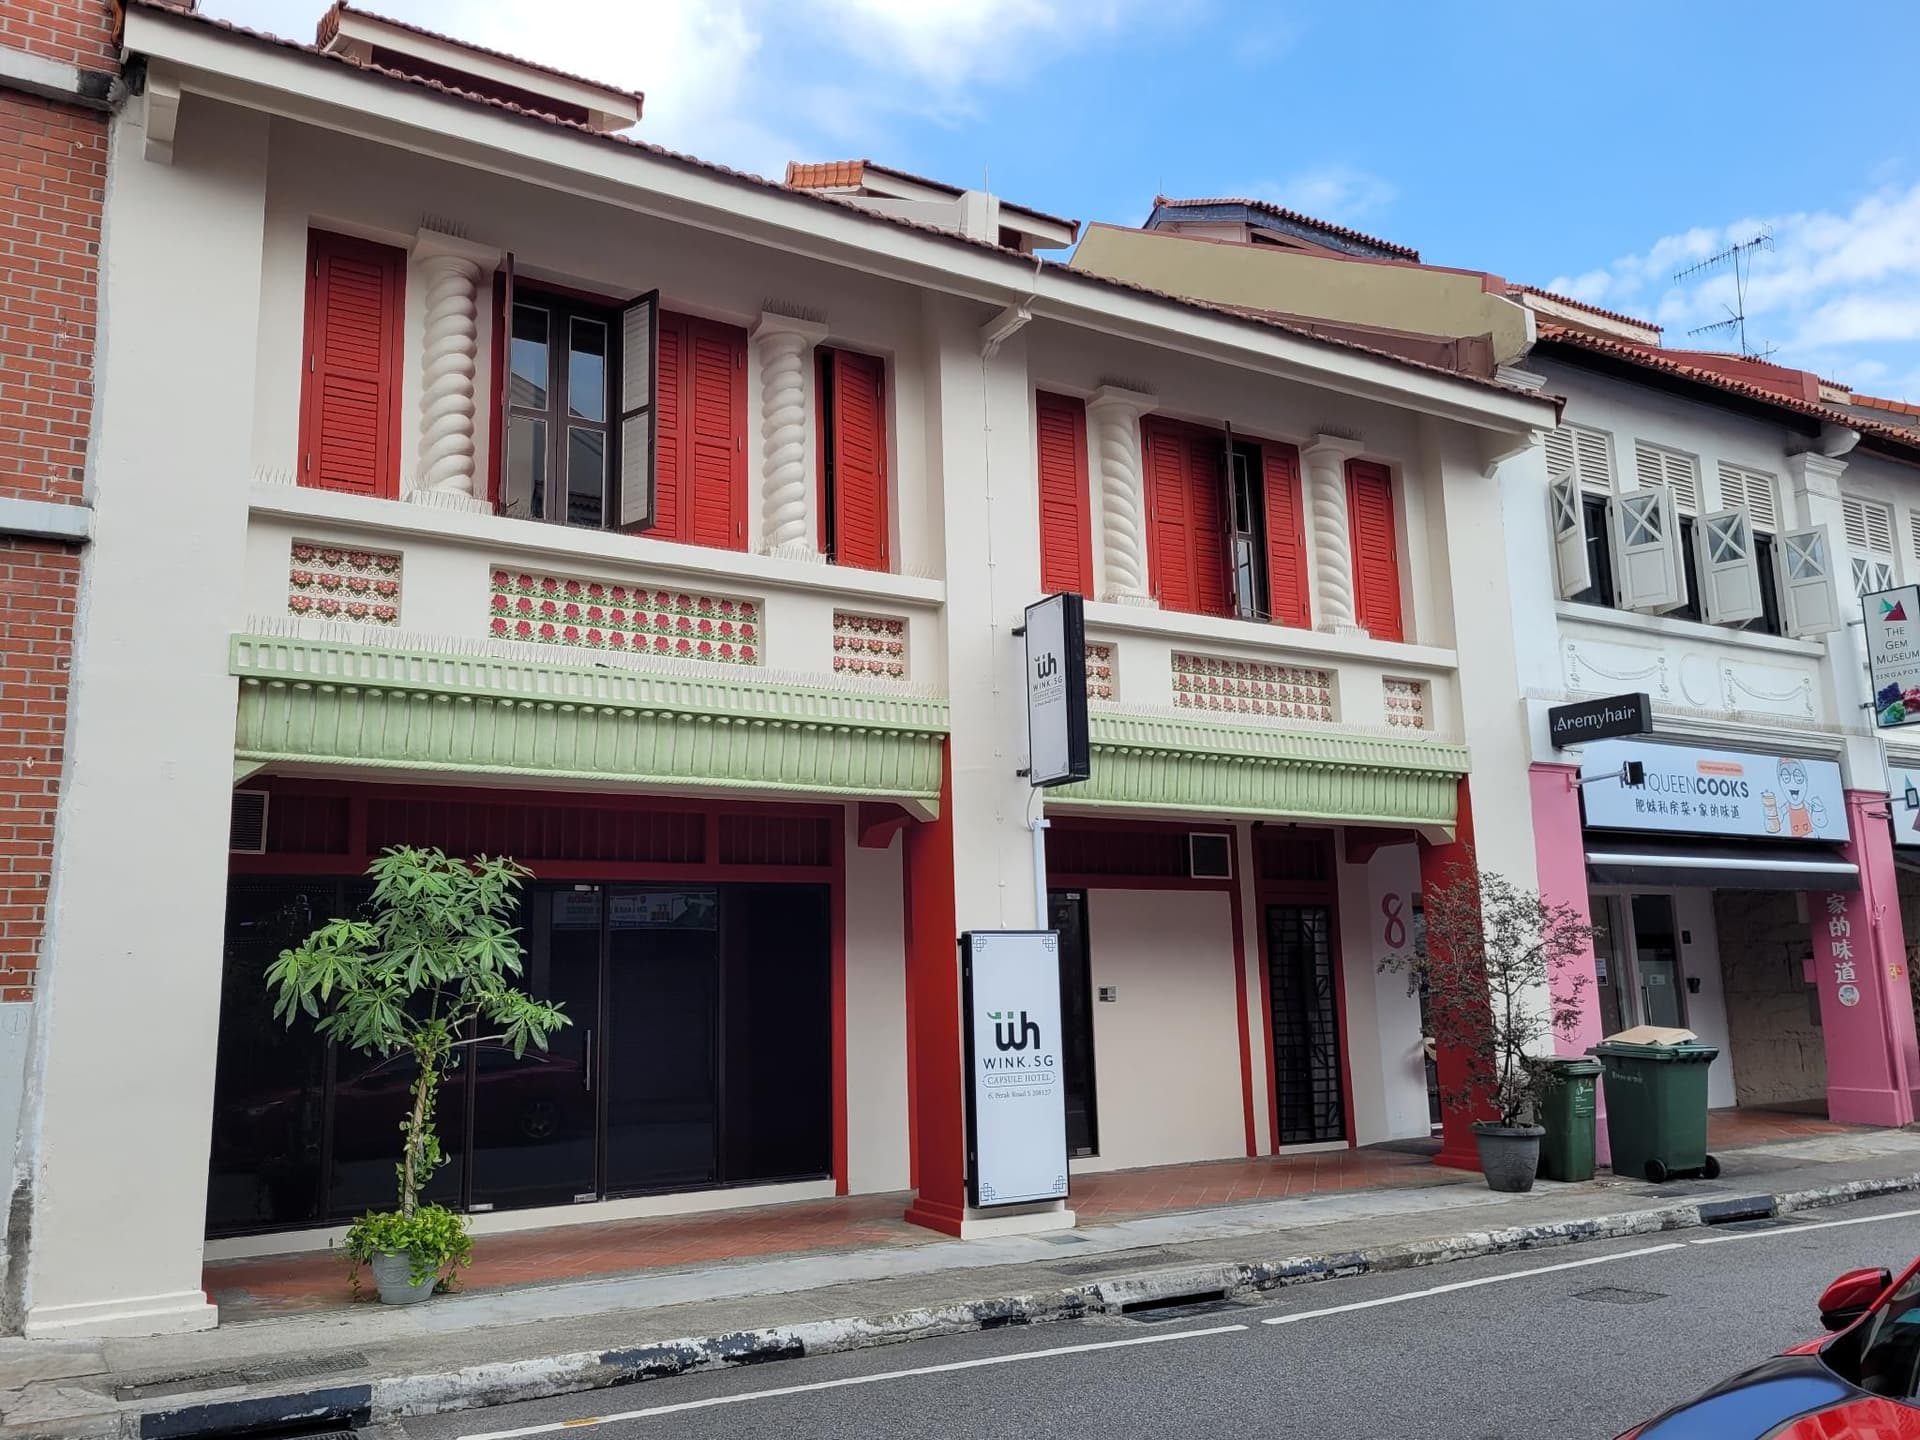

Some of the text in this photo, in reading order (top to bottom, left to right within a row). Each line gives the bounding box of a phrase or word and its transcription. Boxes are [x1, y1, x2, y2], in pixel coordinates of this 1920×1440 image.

[1884, 626, 1905, 637] THE
[1885, 640, 1908, 650] GEM
[1876, 649, 1920, 664] MUSEUM
[1032, 675, 1063, 692] WINK.SG
[1553, 705, 1636, 732] Aremyhair
[1382, 892, 1406, 949] 8
[1826, 893, 1858, 984] 家的味道
[982, 1054, 1054, 1070] WINK.SG
[987, 1073, 1051, 1085] CAPSULE HOTEL
